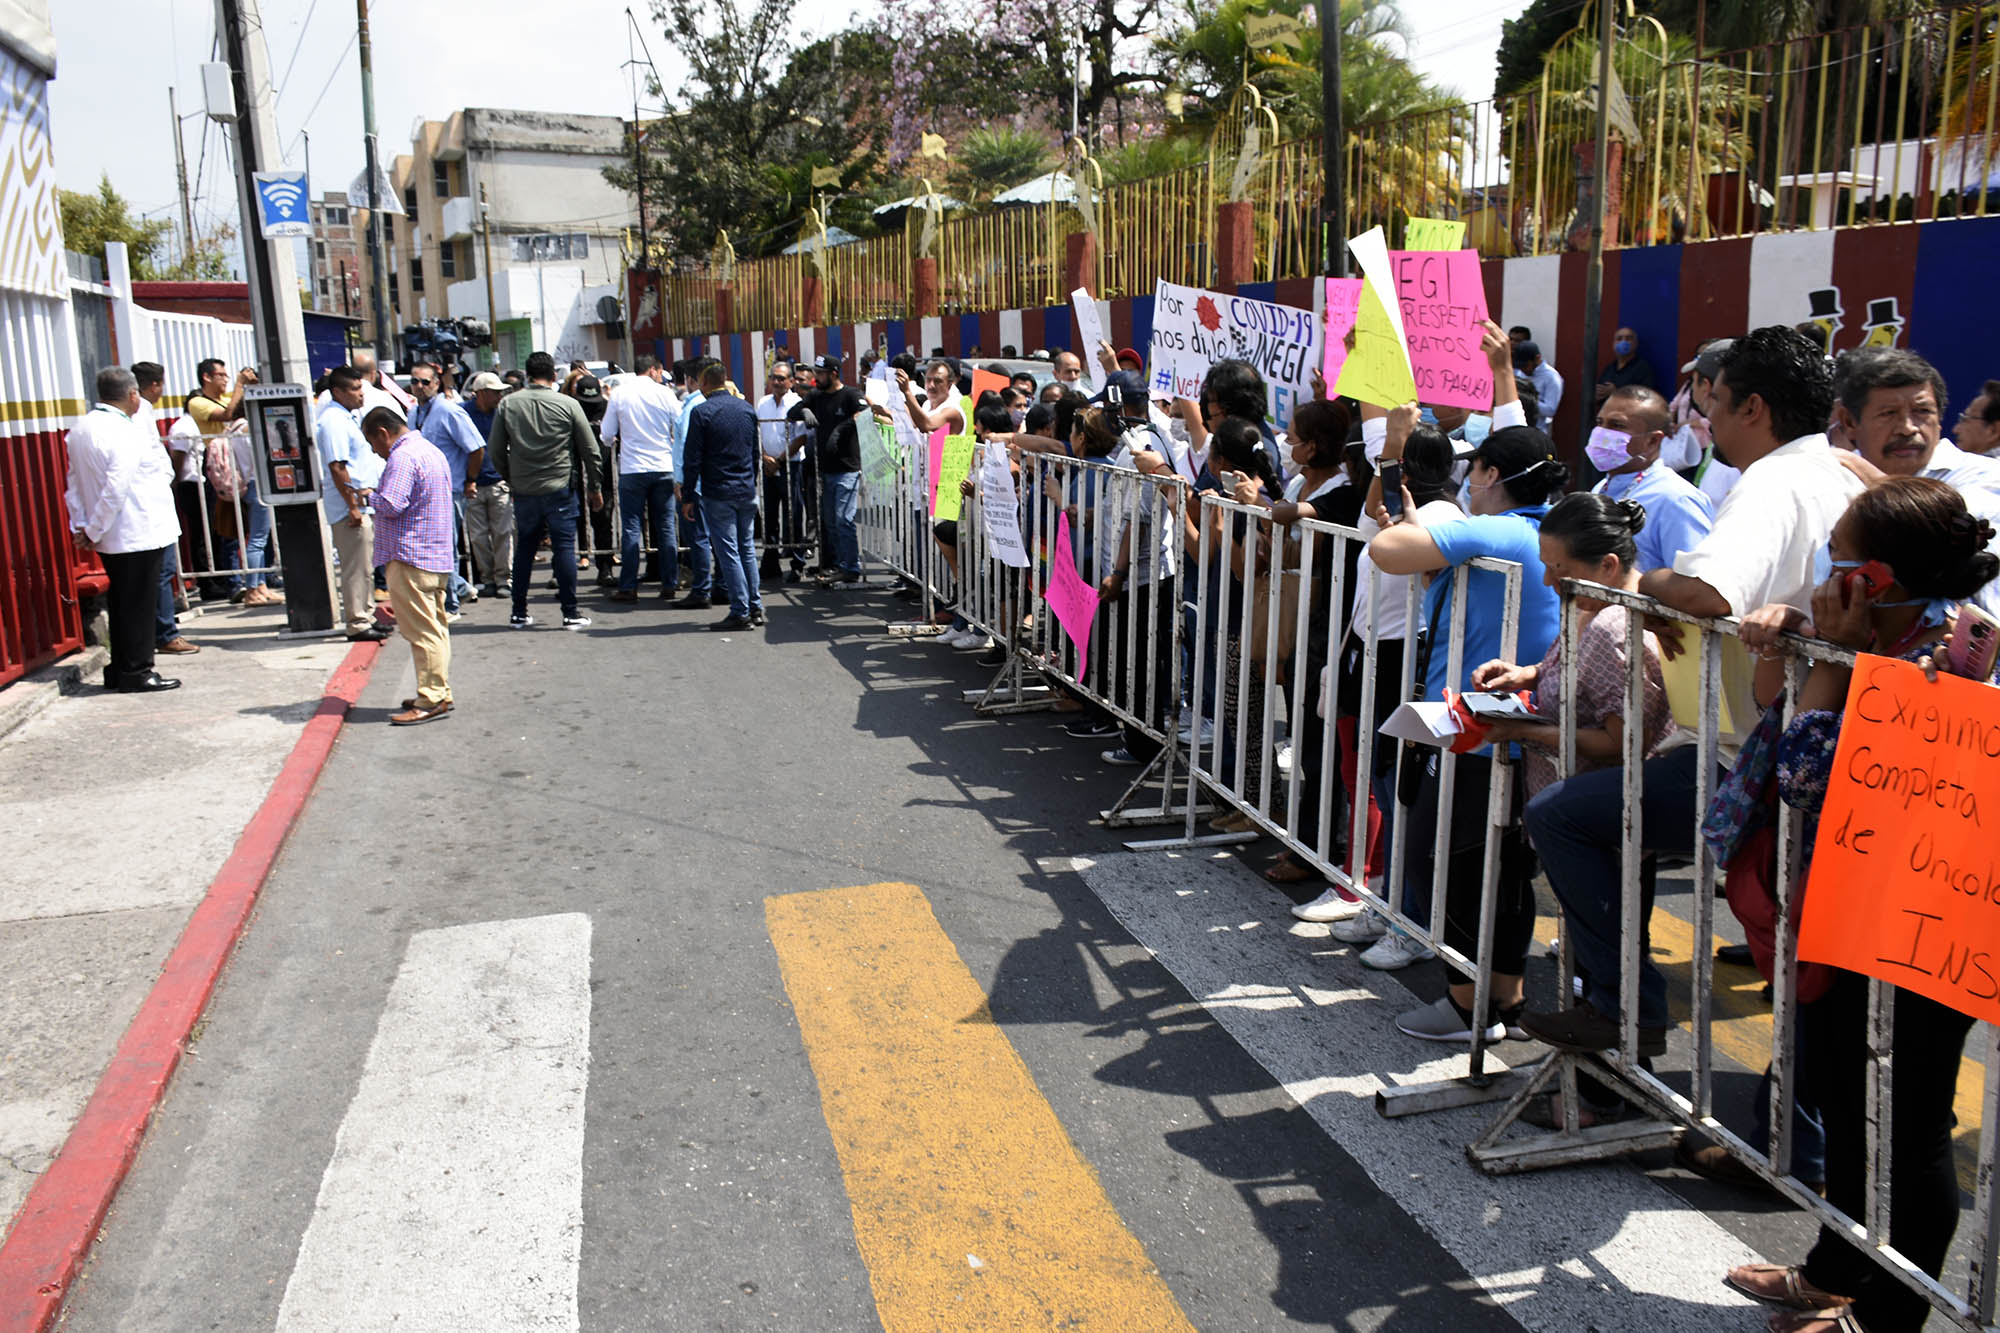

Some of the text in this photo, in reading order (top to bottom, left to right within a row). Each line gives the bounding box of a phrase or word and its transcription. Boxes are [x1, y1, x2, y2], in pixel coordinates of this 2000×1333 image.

[1160, 283, 1184, 316] Por
[1231, 298, 1313, 347] COVID-19
[1402, 302, 1487, 332] RESPETA
[1152, 328, 1185, 350] nos
[1251, 332, 1307, 386] INEGI
[1849, 746, 1981, 827] Completa
[1834, 808, 1875, 855] de
[1876, 909, 2000, 1004] INS
